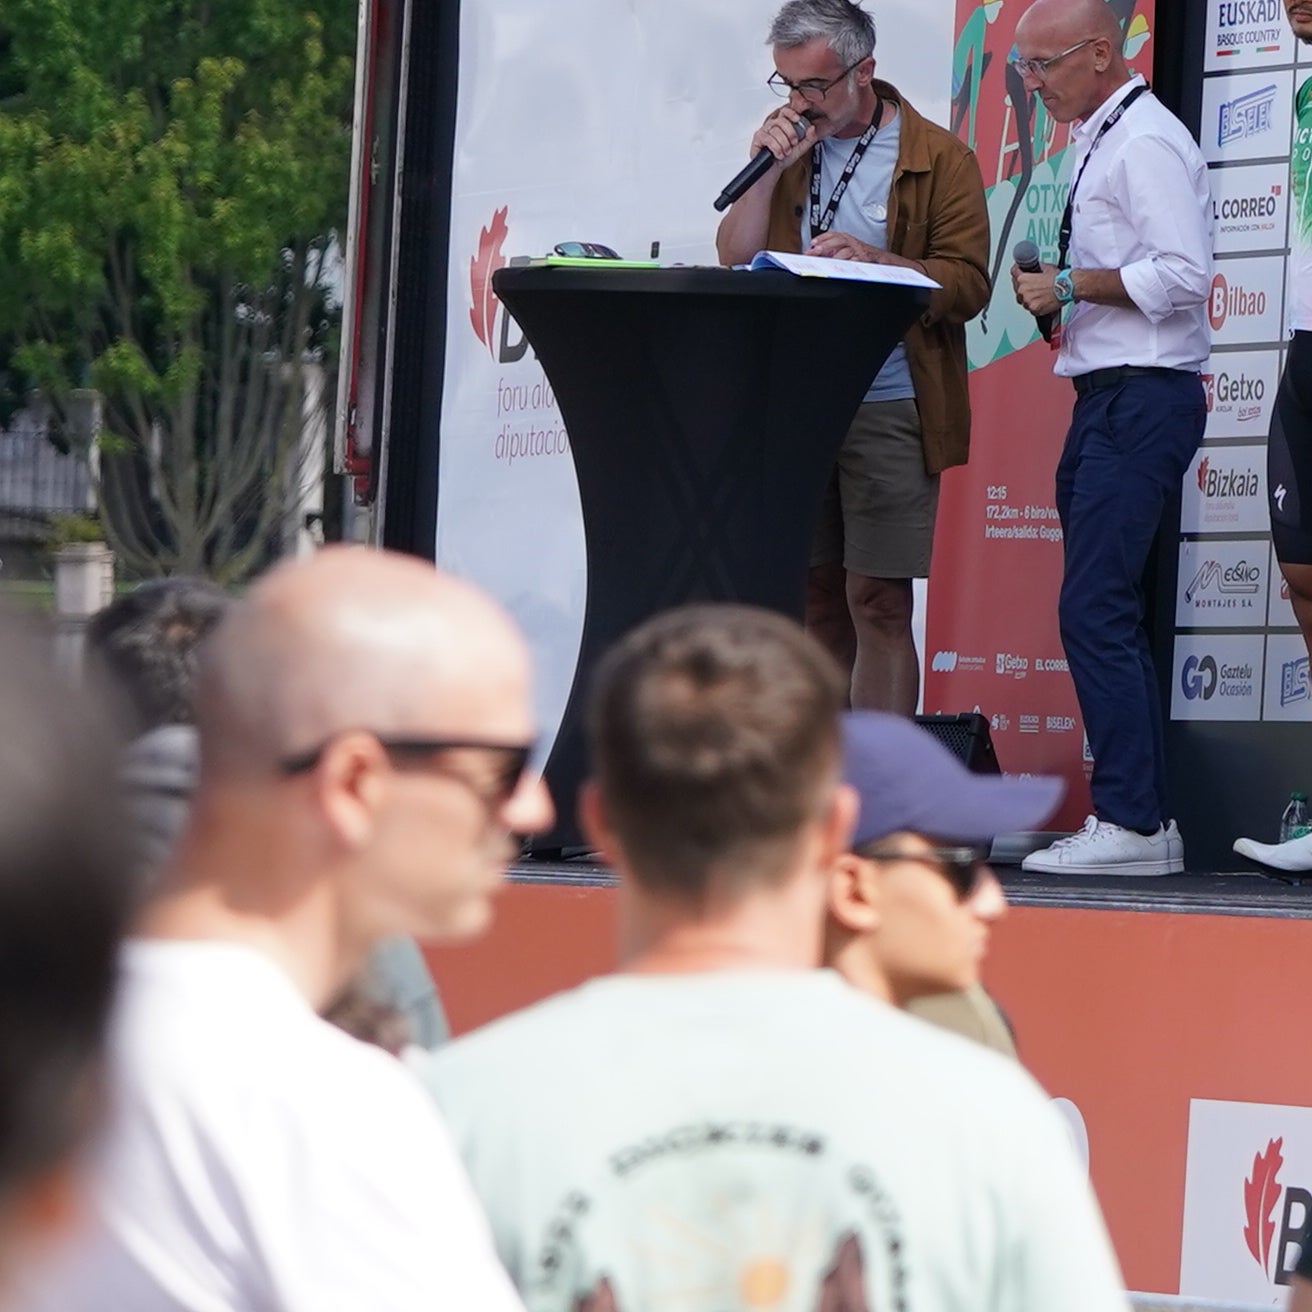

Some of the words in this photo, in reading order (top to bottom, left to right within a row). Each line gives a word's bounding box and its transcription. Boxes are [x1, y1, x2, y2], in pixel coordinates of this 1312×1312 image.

[1217, 32, 1244, 46] BASQUE
[1222, 196, 1276, 220] CORREO
[1212, 286, 1266, 319] Bilbao
[1216, 372, 1265, 402] Getxo
[1206, 468, 1259, 498] Bizkaia
[1195, 599, 1237, 608] MONTAJES
[1045, 658, 1069, 672] CORRE
[1220, 663, 1252, 680] Gaztelu
